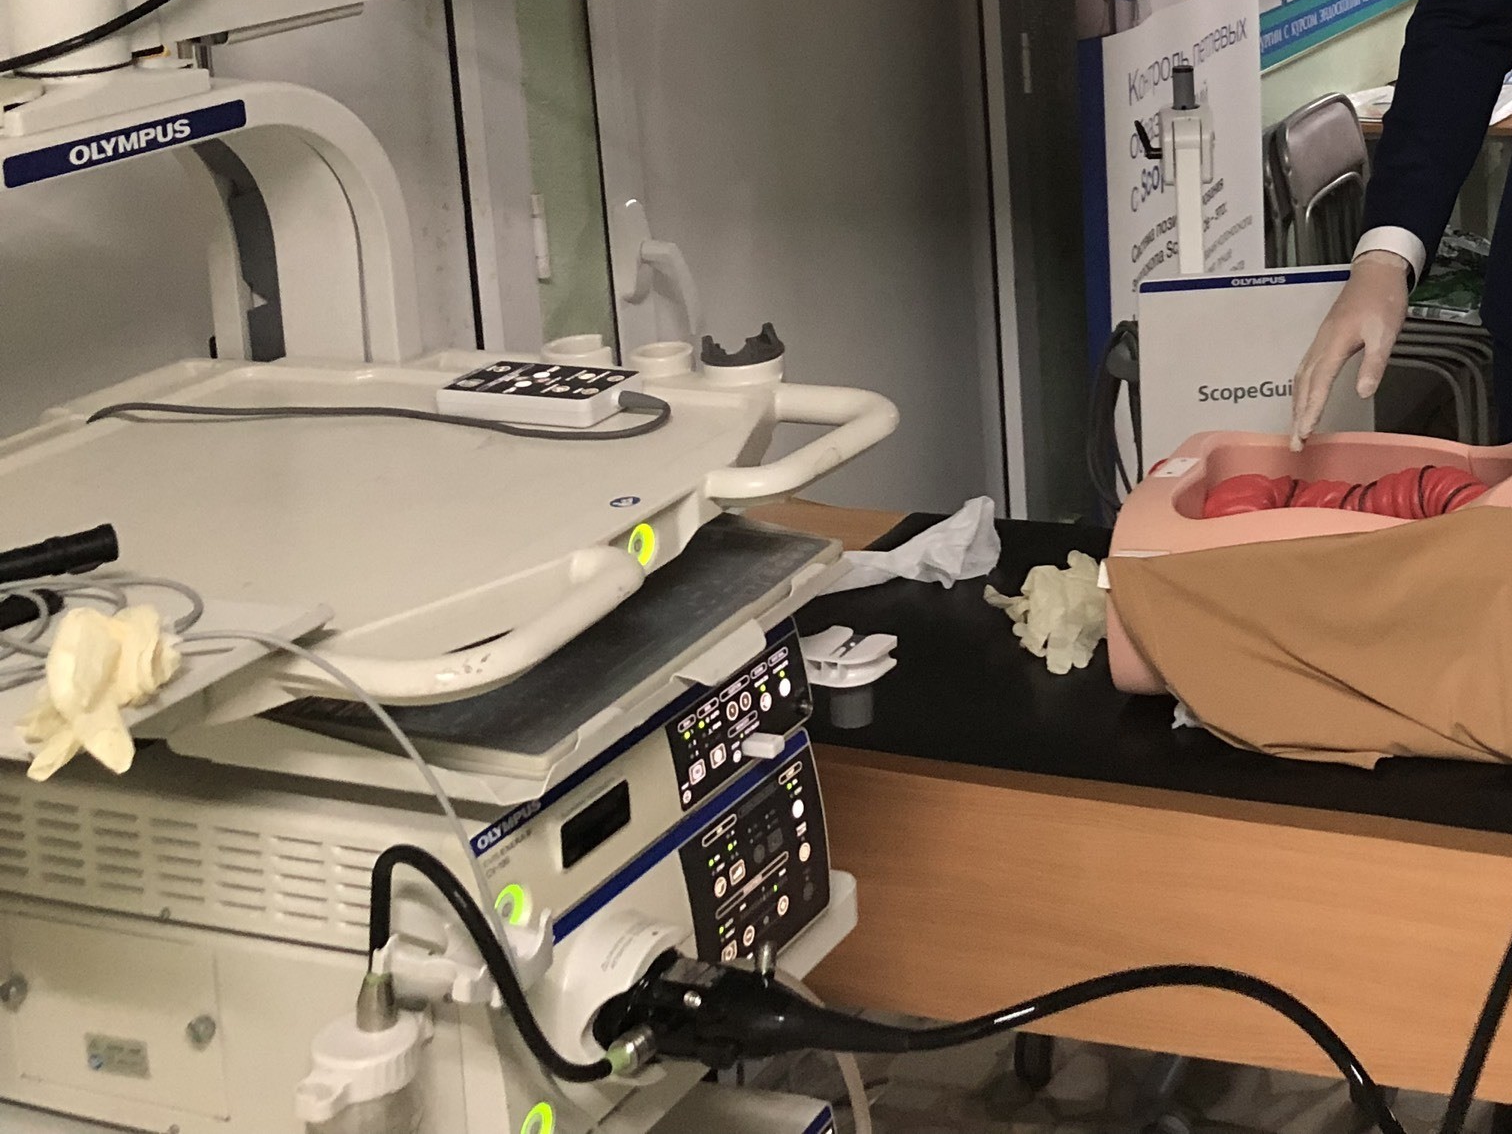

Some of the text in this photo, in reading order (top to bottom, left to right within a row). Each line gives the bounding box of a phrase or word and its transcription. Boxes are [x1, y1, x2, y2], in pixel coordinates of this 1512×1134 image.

[69, 118, 191, 166] OLYMPUS
[1231, 275, 1286, 286] OLYMPUS
[476, 799, 542, 850] OLYMPUS
